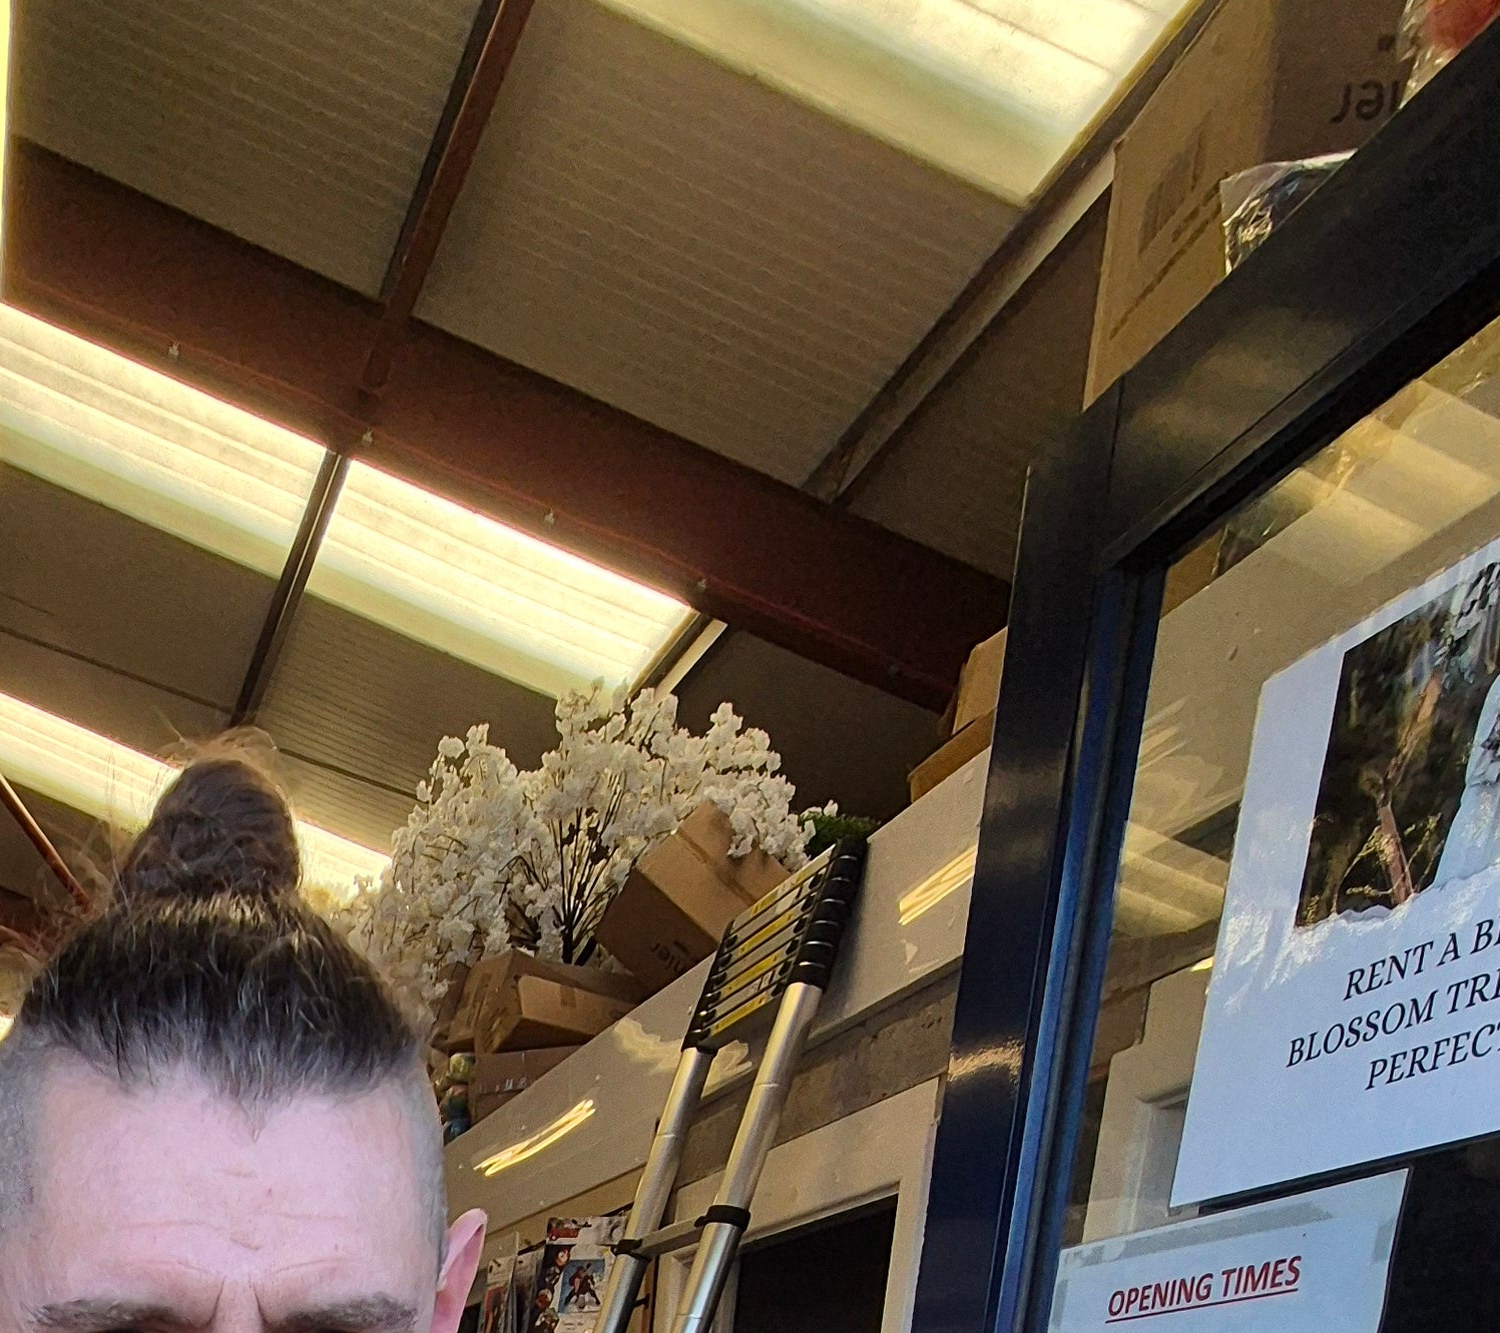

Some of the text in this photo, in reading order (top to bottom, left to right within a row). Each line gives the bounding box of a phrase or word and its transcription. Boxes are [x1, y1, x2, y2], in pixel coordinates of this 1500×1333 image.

[1343, 941, 1434, 1000] RENT
[1436, 932, 1461, 967] A
[1286, 990, 1439, 1068] BLOSSOM
[1365, 1021, 1500, 1091] PERFEC
[1107, 1255, 1302, 1317] OPENING TIMES
